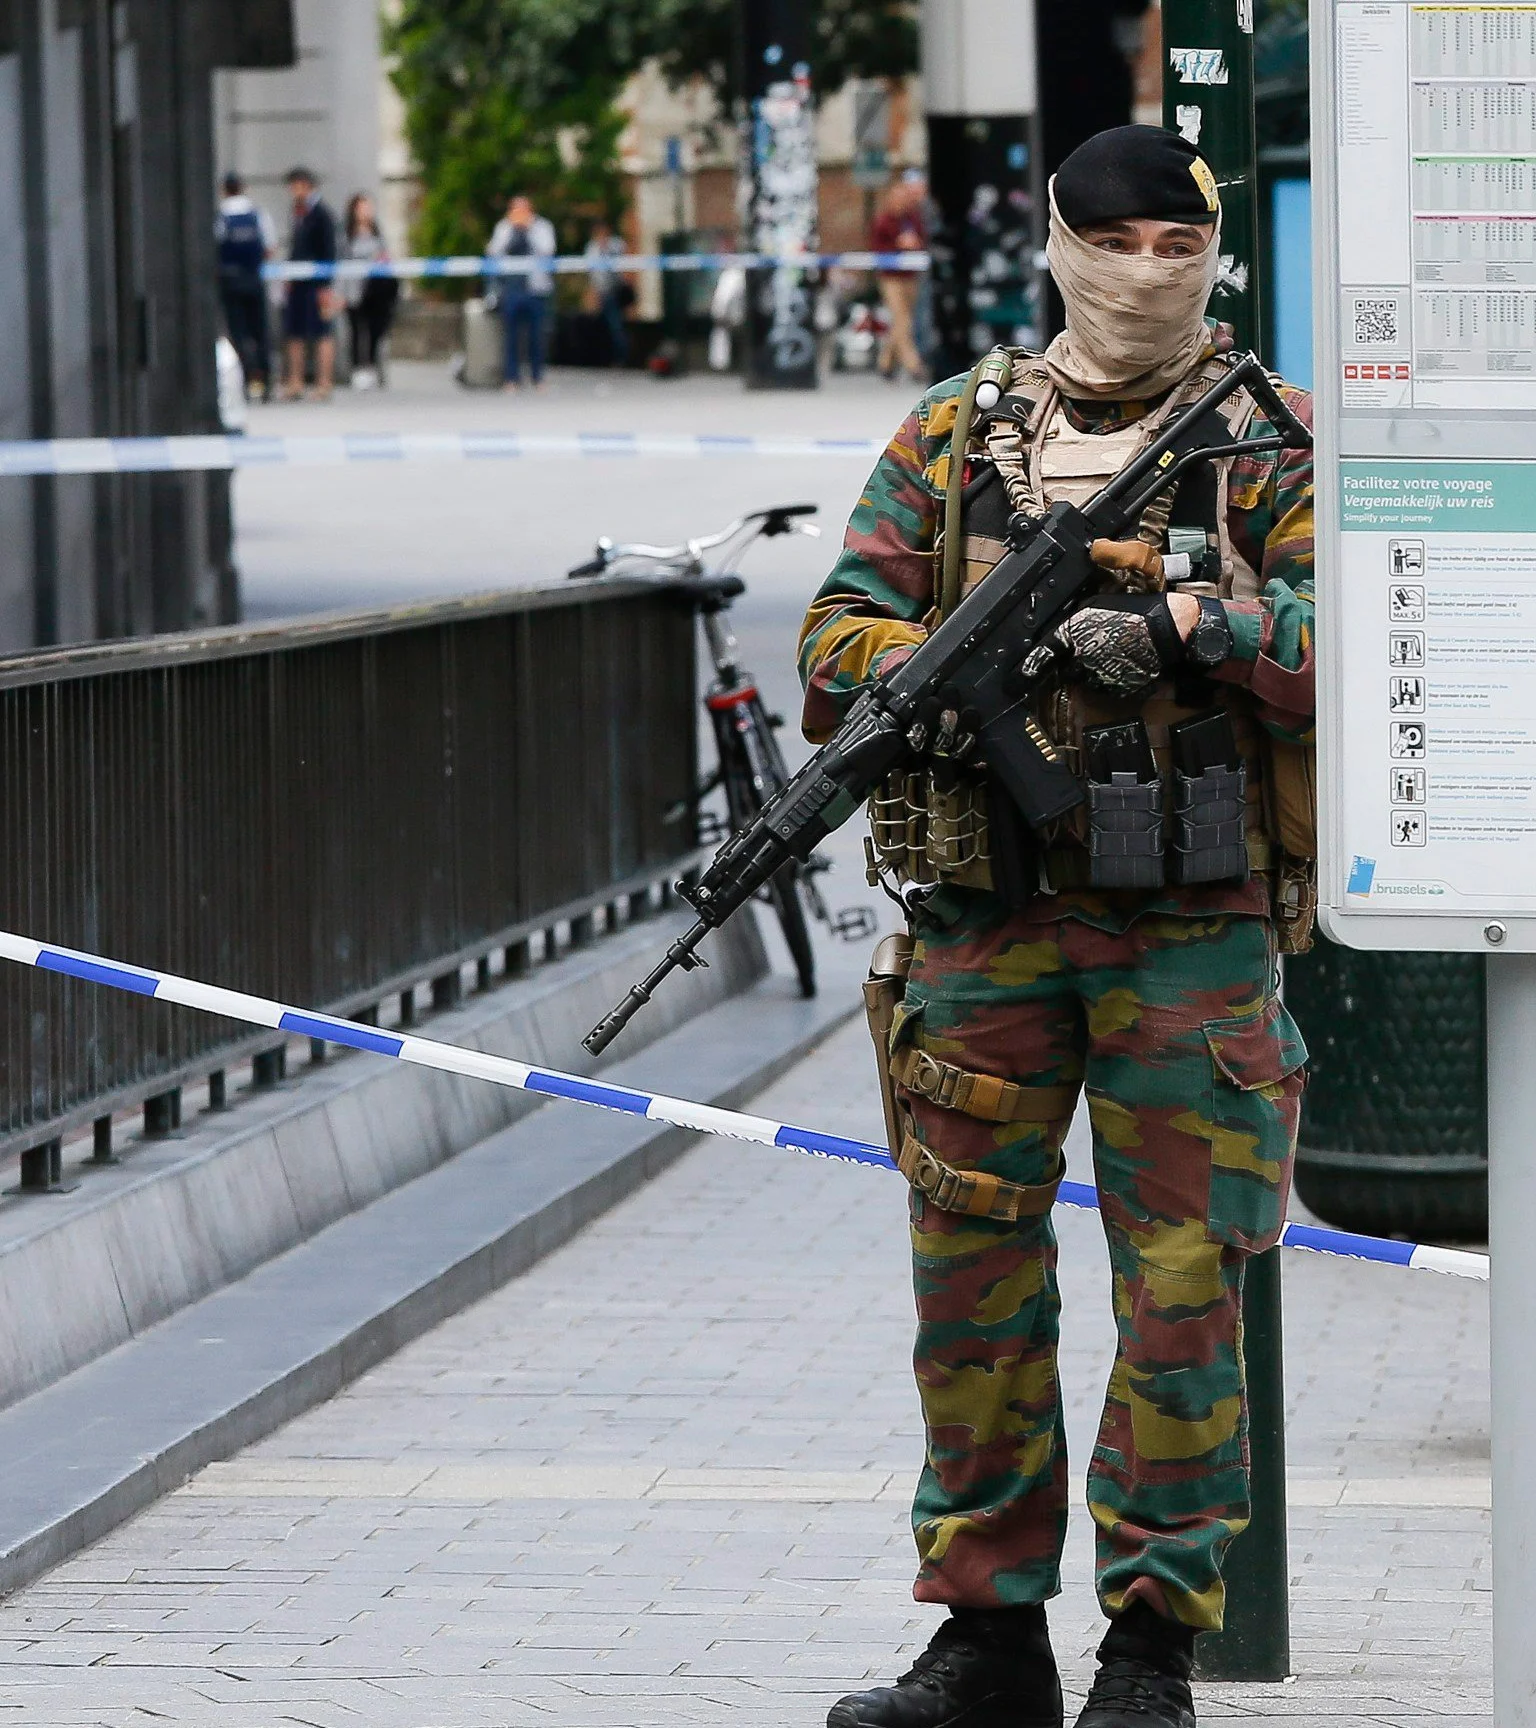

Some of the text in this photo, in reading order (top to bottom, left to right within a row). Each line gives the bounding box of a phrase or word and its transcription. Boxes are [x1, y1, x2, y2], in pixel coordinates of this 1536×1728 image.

[1343, 476, 1493, 493] Facilitez votre voyage
[1344, 494, 1495, 510] Vergemakkelijk uw reis
[1343, 513, 1378, 523] Simplify
[1379, 514, 1400, 523] your
